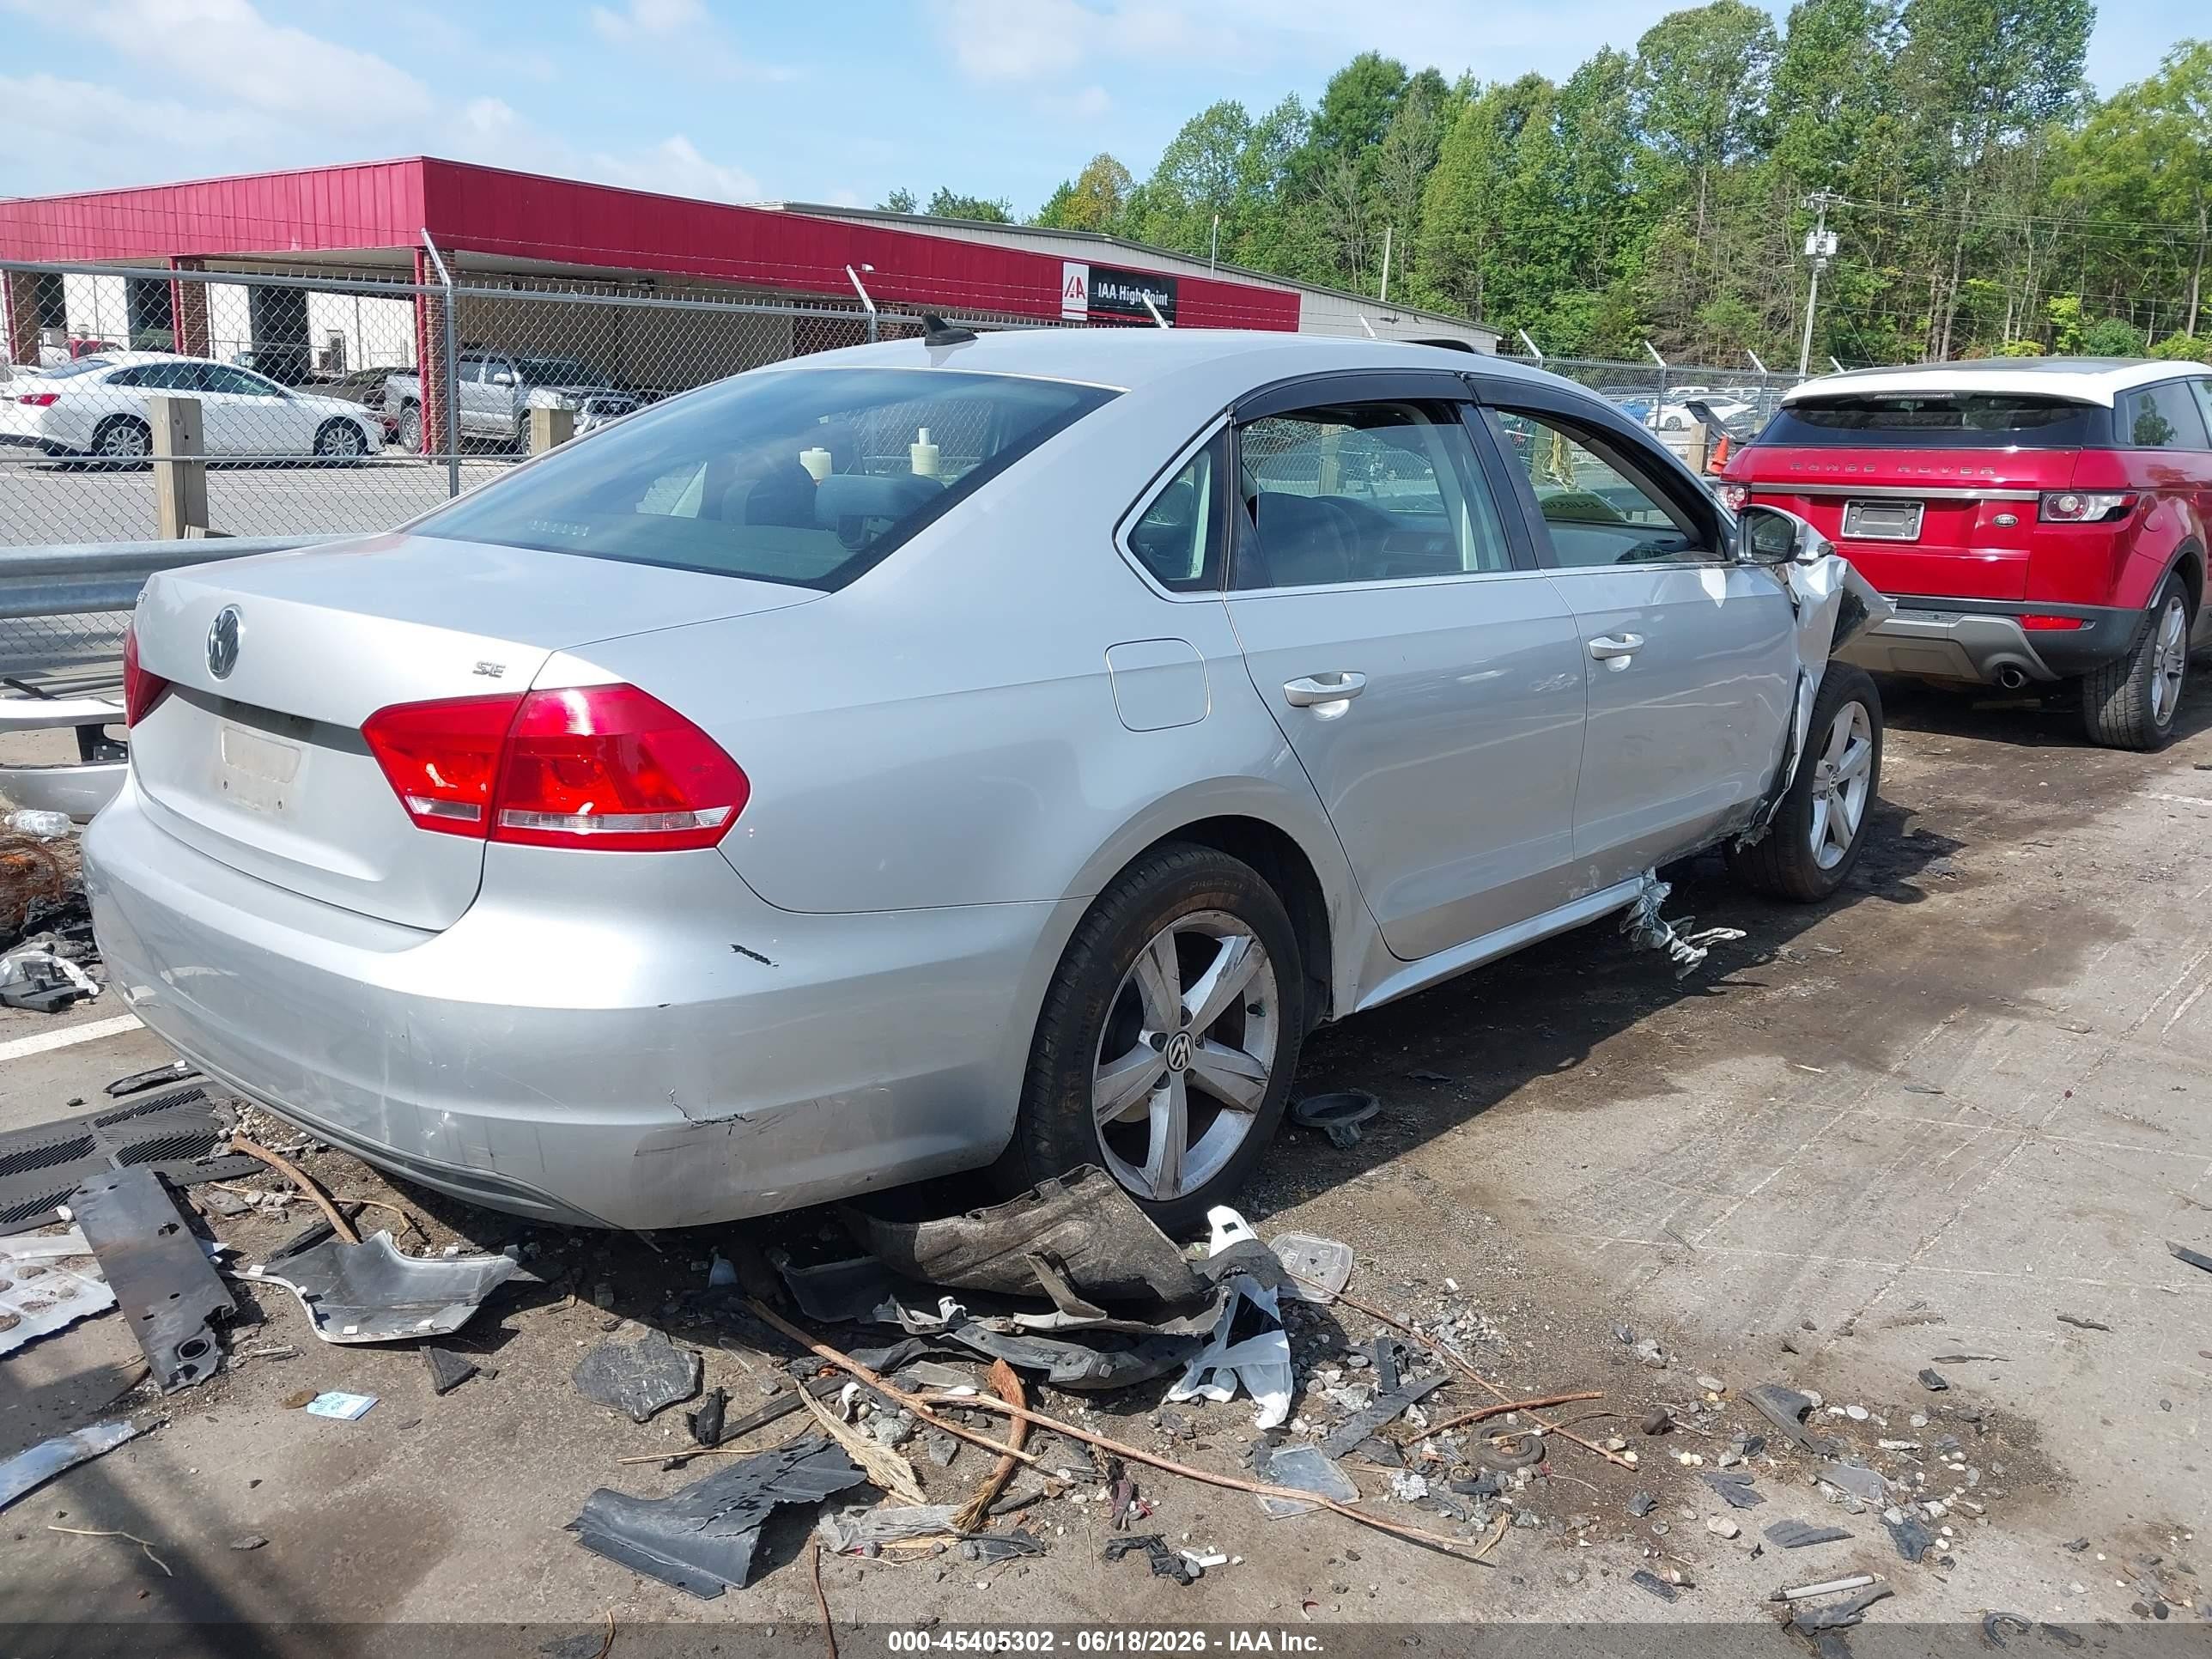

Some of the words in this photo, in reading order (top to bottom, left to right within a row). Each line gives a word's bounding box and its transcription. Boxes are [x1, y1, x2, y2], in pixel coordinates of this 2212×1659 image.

[1097, 282, 1117, 300] IAA
[1119, 284, 1141, 306] High
[1144, 289, 1169, 307] Point
[472, 660, 506, 678] SE
